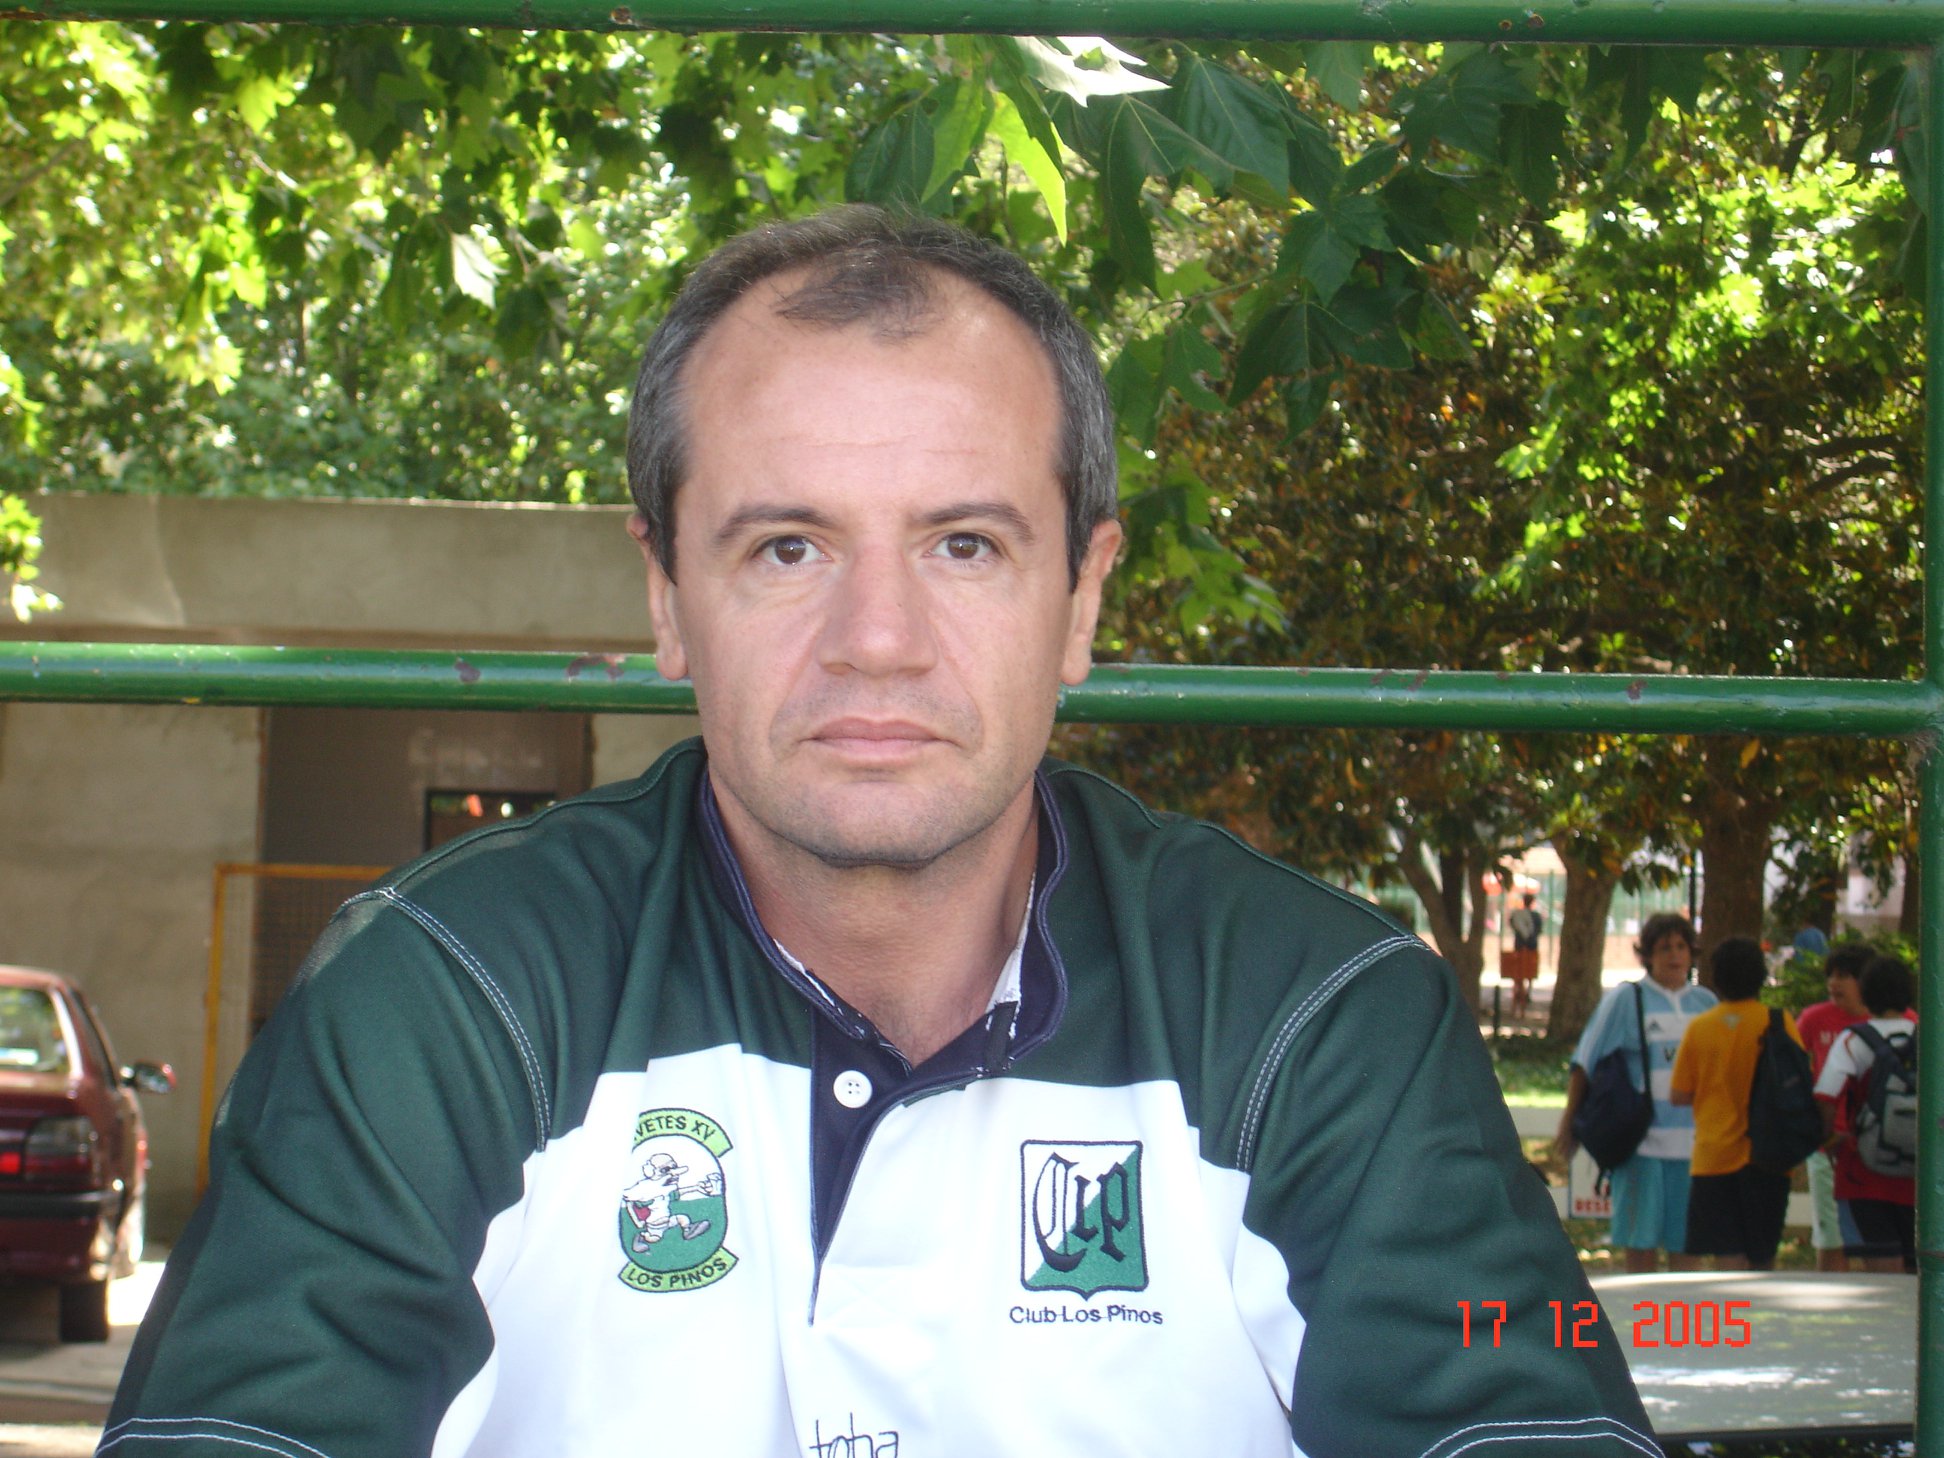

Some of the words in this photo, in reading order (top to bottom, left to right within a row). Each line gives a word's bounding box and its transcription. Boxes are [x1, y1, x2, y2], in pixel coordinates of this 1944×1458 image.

[691, 1119, 716, 1140] XV
[626, 1268, 663, 1288] LOS
[669, 1257, 728, 1288] PINOS
[1009, 1305, 1058, 1324] Club
[1062, 1305, 1101, 1323] Los
[1106, 1304, 1164, 1325] Pinos
